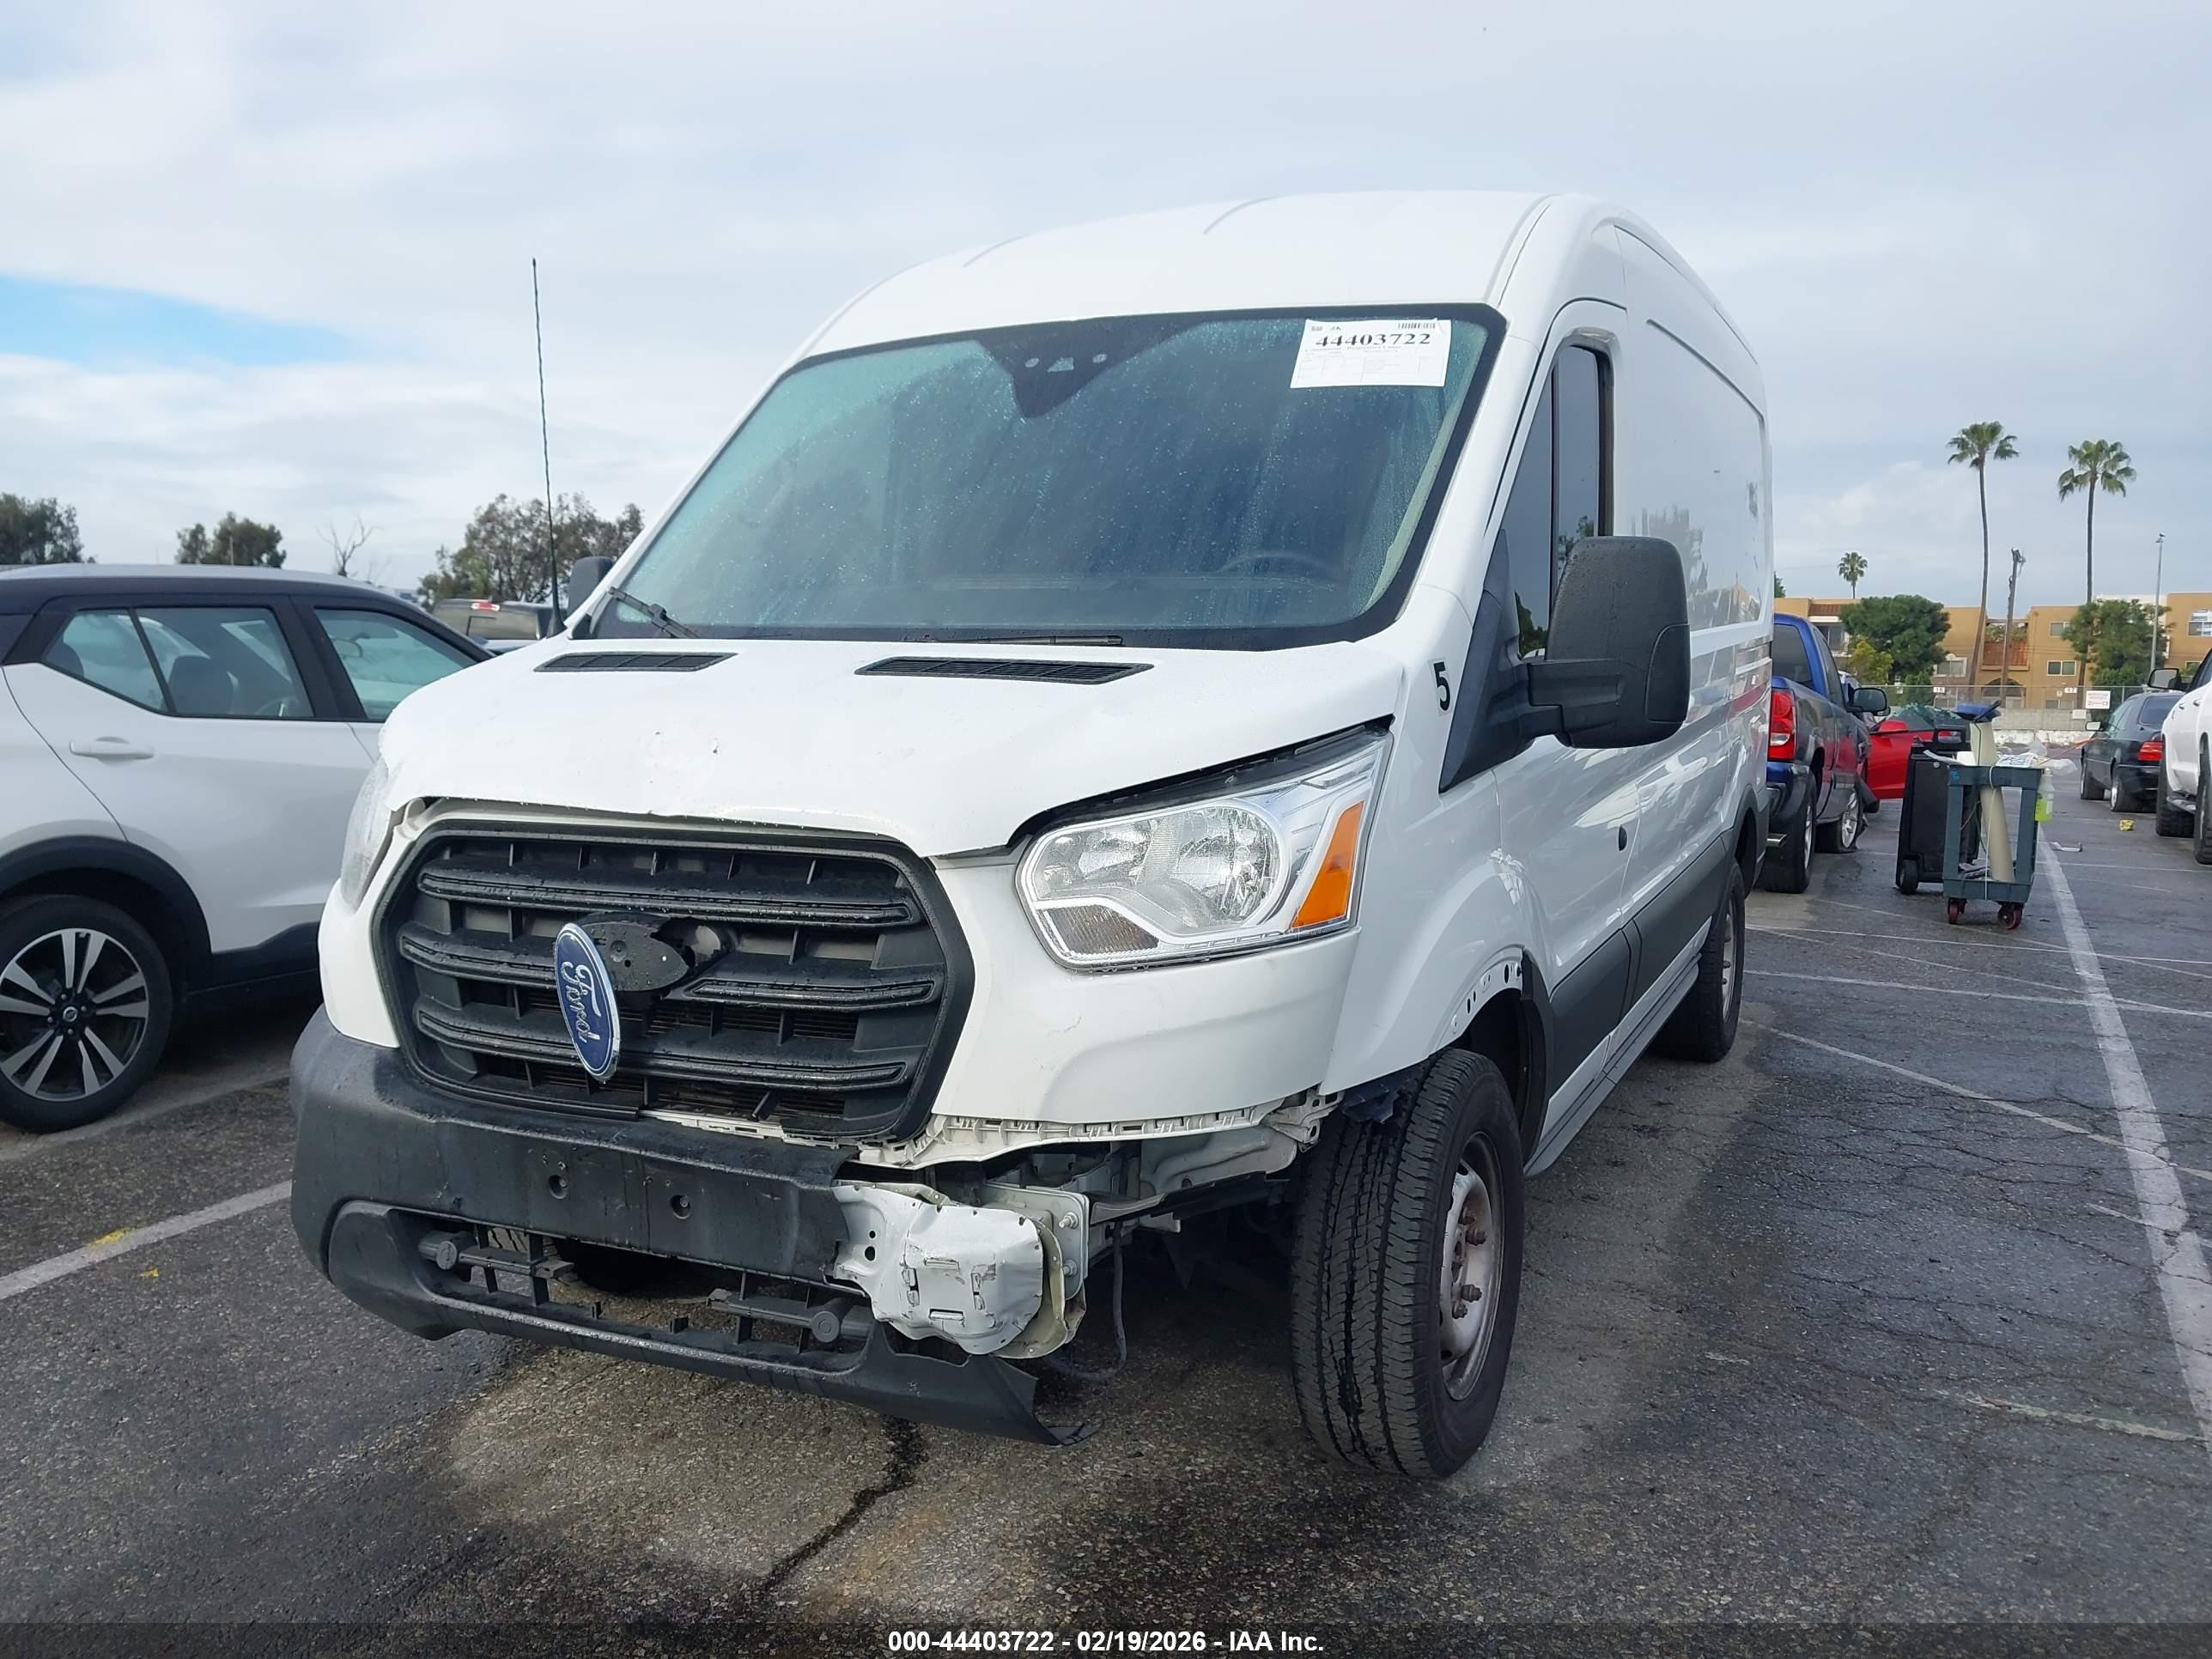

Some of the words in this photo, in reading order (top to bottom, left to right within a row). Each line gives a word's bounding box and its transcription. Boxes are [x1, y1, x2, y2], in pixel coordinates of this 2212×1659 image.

[1316, 332, 1431, 346] 44403722
[1433, 661, 1450, 711] 5
[561, 961, 602, 1043] Ford
